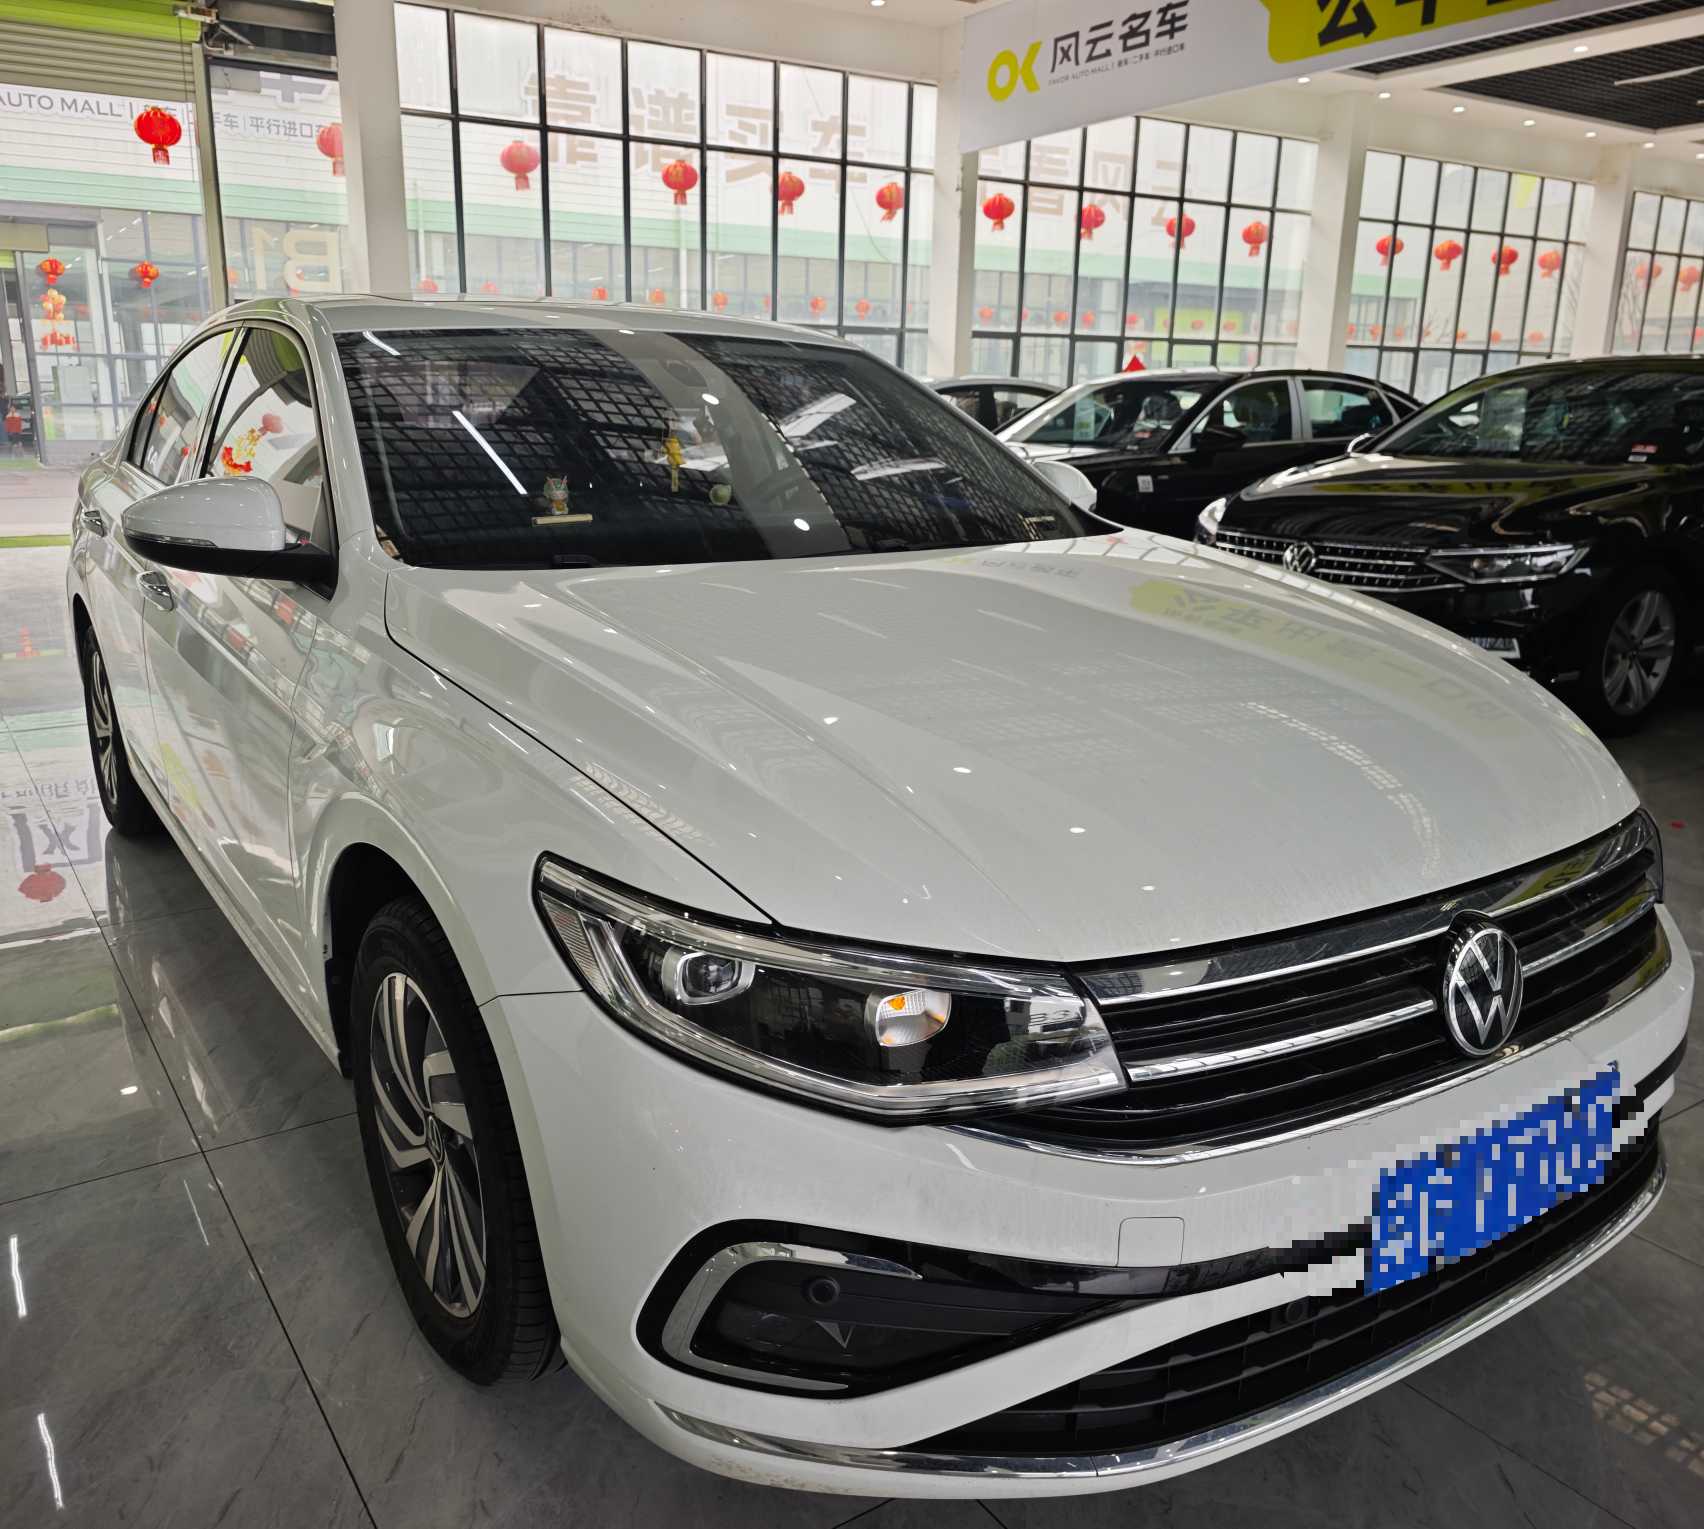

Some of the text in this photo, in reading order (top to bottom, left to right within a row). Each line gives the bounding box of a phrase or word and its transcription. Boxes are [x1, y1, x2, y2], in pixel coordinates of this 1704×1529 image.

[1049, 0, 1191, 74] 风云名车
[986, 40, 1043, 103] OK
[60, 97, 123, 118] MALL
[1449, 928, 1520, 1053] VW
